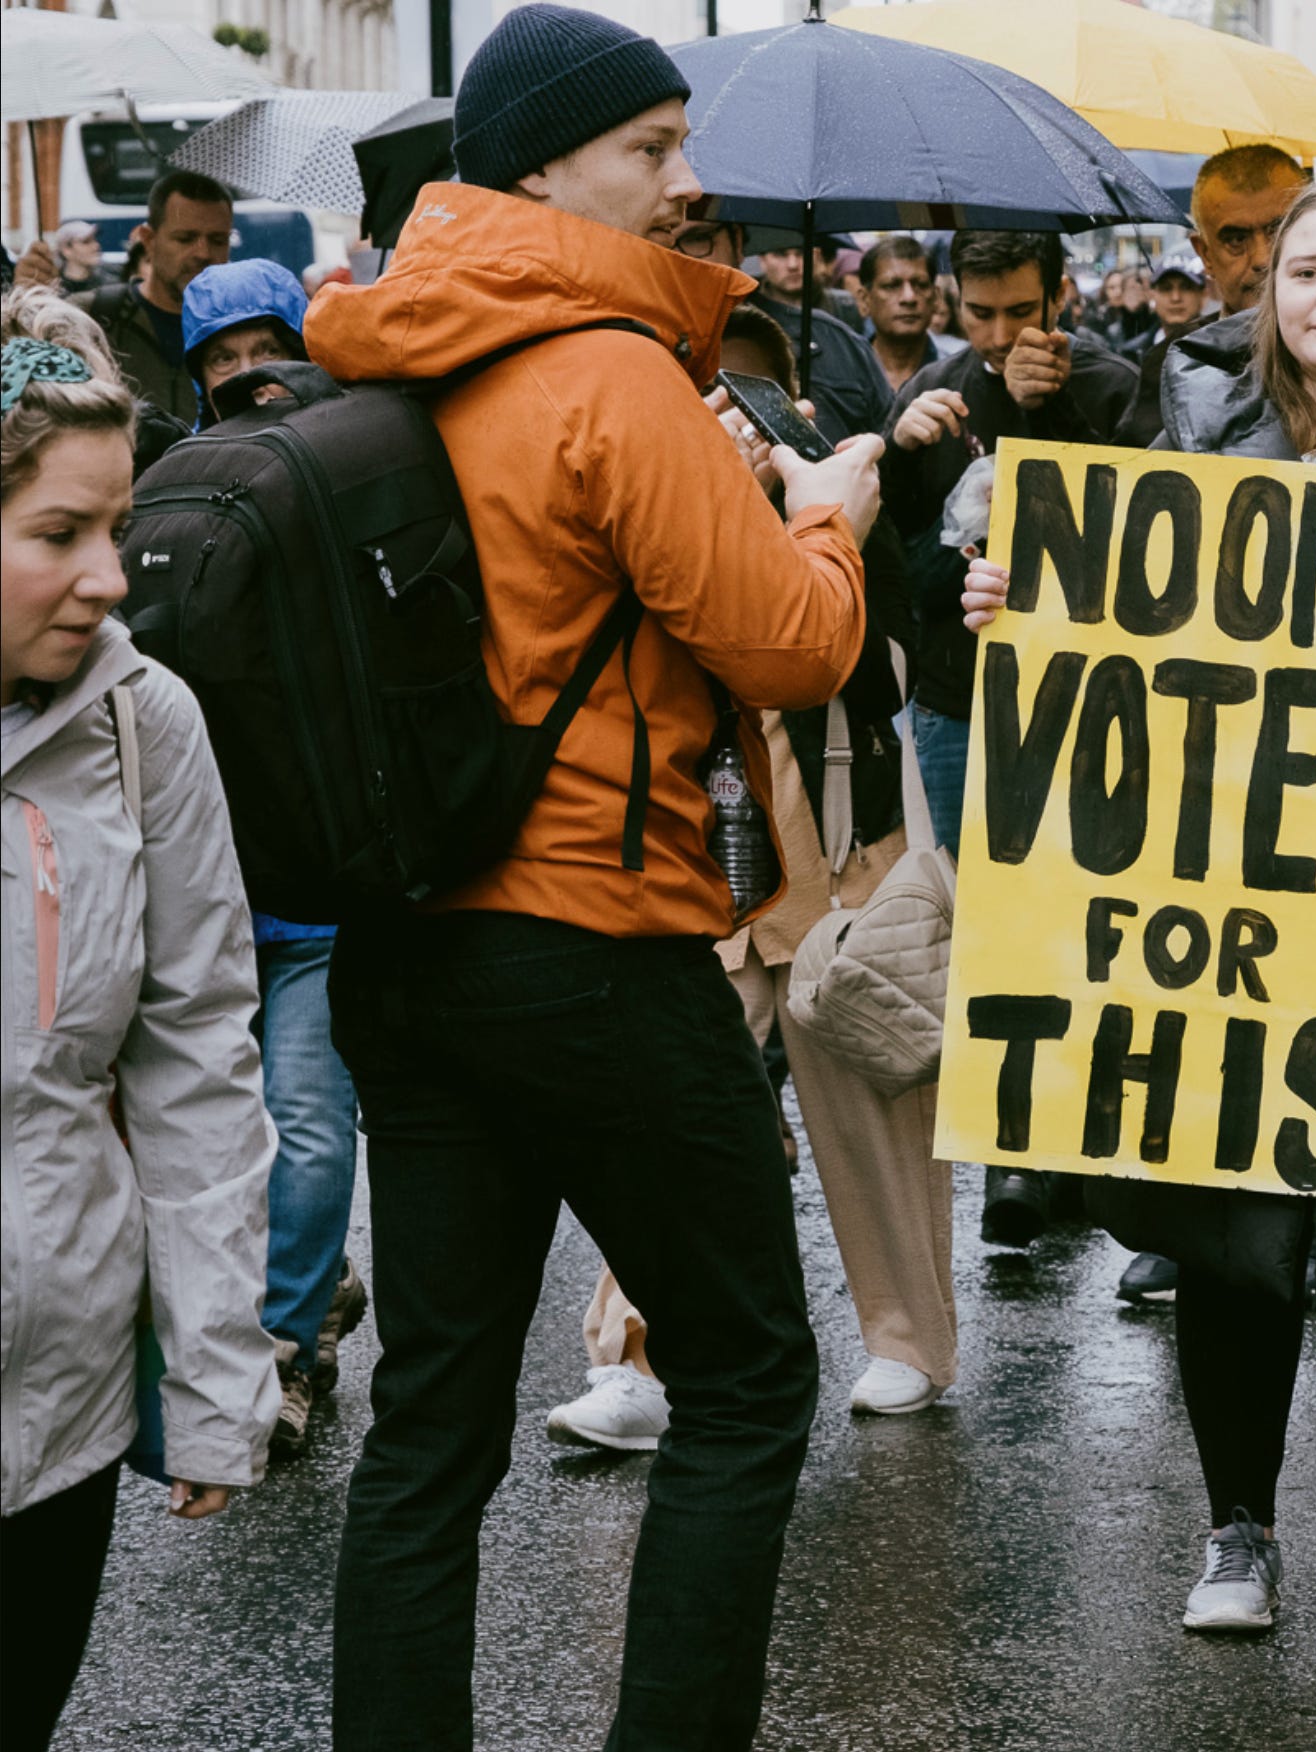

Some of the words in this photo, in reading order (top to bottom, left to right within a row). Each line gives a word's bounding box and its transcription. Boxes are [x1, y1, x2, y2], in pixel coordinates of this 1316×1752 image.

[1006, 458, 1202, 637] NO
[711, 774, 739, 795] Life
[1086, 897, 1278, 1002] FOR
